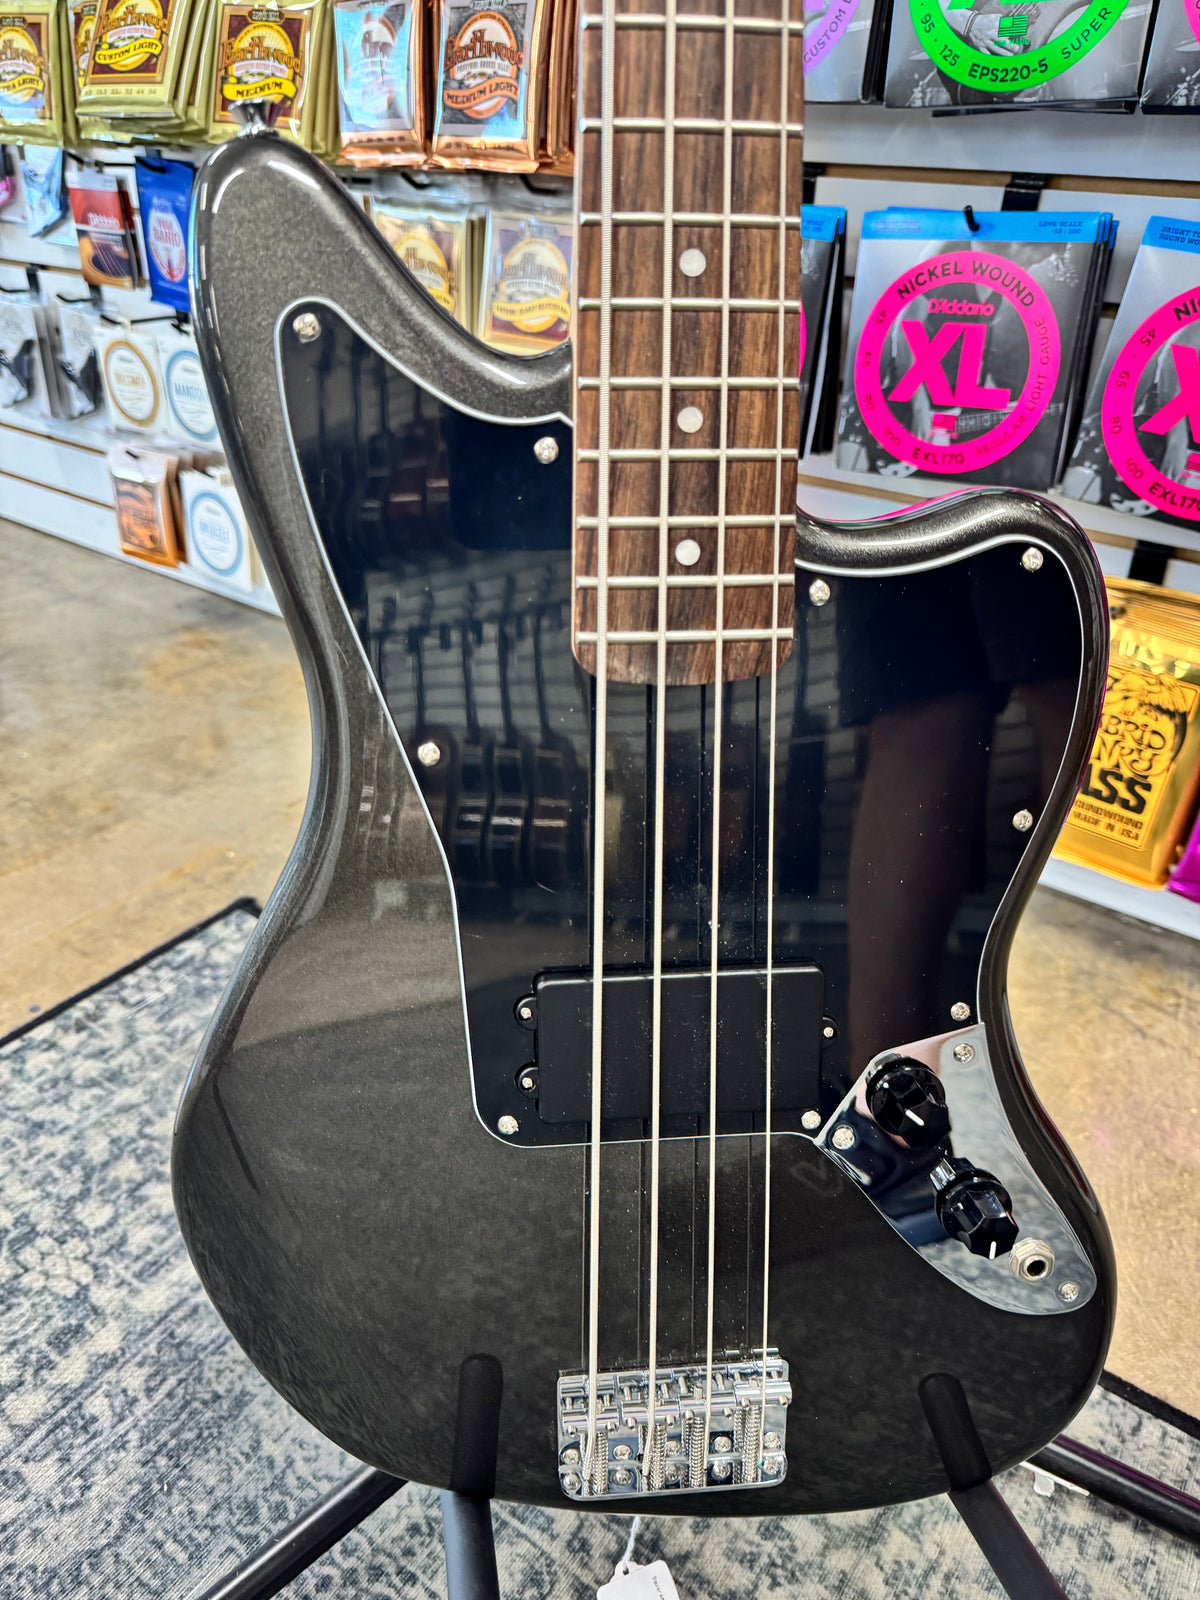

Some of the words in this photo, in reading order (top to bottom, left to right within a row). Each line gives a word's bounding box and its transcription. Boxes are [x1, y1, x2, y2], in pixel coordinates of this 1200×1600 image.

[803, 8, 847, 63] CUSTOM
[920, 13, 936, 34] 95
[939, 44, 960, 66] 125
[1061, 6, 1112, 60] SUPER
[97, 47, 131, 61] CUSTOM
[133, 41, 159, 52] LIGHT
[967, 58, 1049, 83] EPS220-5
[236, 81, 283, 98] MEDIUM
[446, 87, 487, 104] MEDIUM
[489, 81, 518, 96] LIGHT
[897, 261, 963, 300] NICKEL
[972, 261, 1035, 307] WOUND
[927, 298, 995, 316] D'Addario
[1035, 316, 1050, 366] GAUGE
[1140, 328, 1156, 346] 45
[887, 319, 1011, 411] XL
[1025, 373, 1047, 411] LIGHT
[976, 415, 1027, 456] REGULAR
[1110, 416, 1121, 434] 80
[912, 447, 965, 464] EXL170
[1123, 456, 1144, 480] 100
